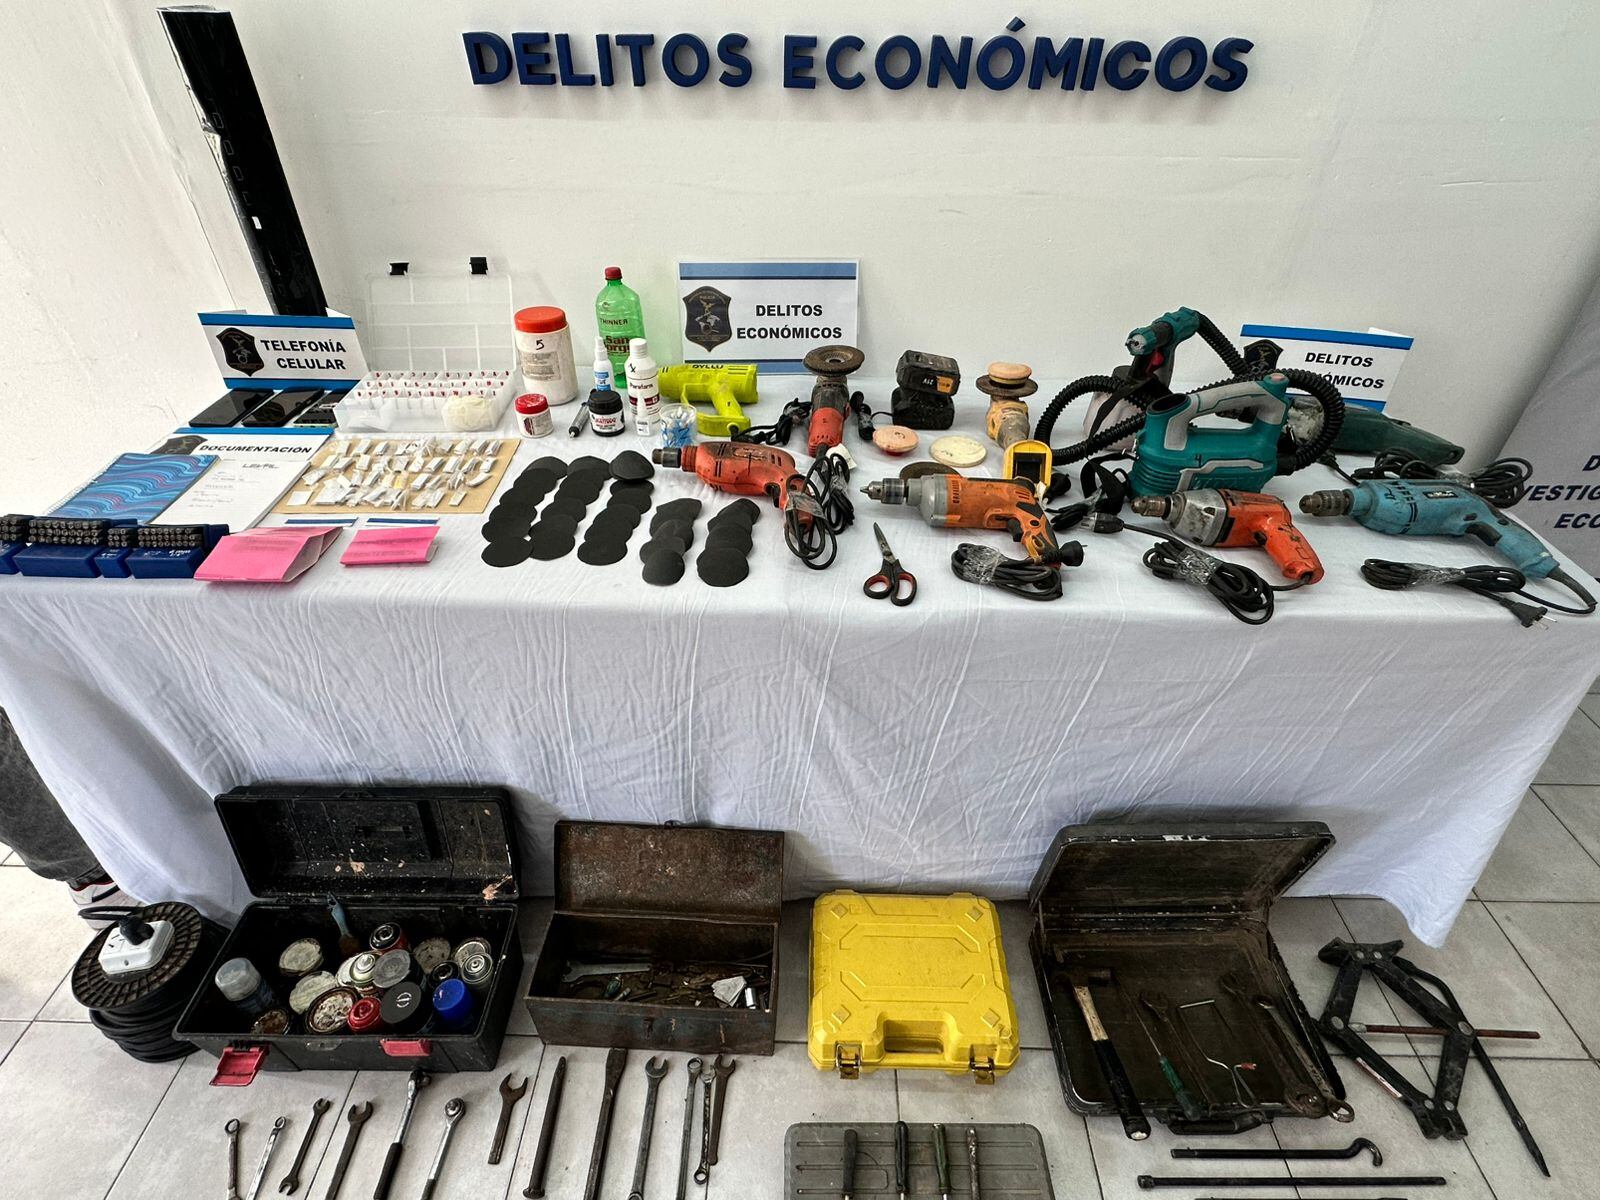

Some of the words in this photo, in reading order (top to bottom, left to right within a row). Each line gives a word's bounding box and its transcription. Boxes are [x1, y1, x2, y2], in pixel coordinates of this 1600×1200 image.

[462, 31, 752, 88] DELITOS
[783, 16, 1255, 92] ECONÓMICOS
[755, 304, 823, 317] DELITOS
[737, 325, 842, 339] ECONÓMICOS
[260, 339, 346, 353] TELEFONÍA
[536, 339, 545, 350] 5
[276, 358, 346, 370] CELULAR
[1305, 352, 1374, 368] DELITOS
[1322, 372, 1385, 389] ÓMICOS
